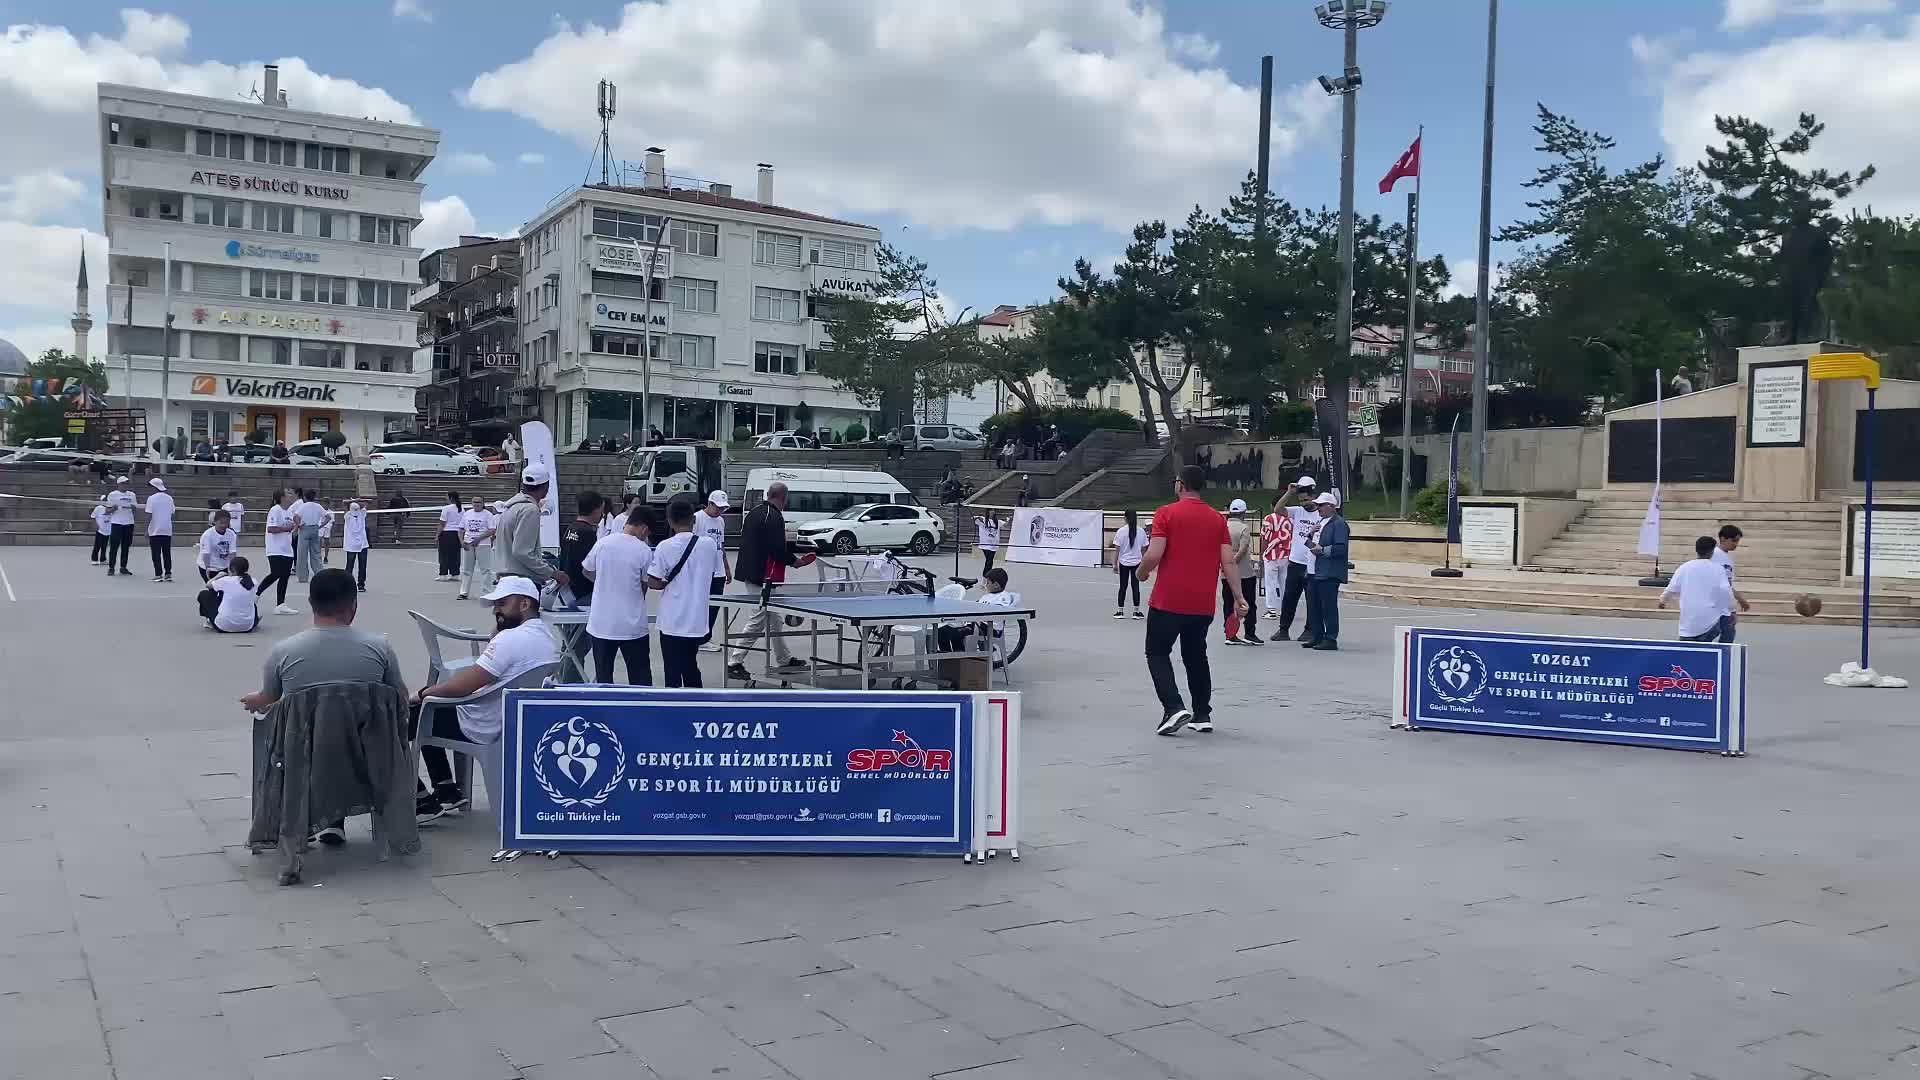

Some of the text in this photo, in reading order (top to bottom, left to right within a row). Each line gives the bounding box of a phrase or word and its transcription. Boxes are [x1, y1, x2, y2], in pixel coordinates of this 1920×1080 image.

[190, 171, 349, 200] ATEŞ SÜRÜCÜ KURSU
[600, 247, 634, 260] KÖSE
[822, 278, 869, 292] AVUKAT
[219, 311, 320, 331] AK PARTİ
[608, 311, 628, 321] CEY
[487, 354, 519, 365] OTEL
[226, 378, 337, 401] VakıfBank
[727, 386, 753, 396] Garanti
[1531, 653, 1591, 667] YOZGAT
[1494, 671, 1629, 688] GENÇLİK HİZMETLERİ
[1638, 676, 1716, 695] SPOR
[1488, 686, 1634, 705] VE SPOR İL MÜDÜRLÜĞÜ
[1429, 703, 1448, 712] Güçlü
[1450, 704, 1471, 713] Türkiye
[692, 722, 779, 739] YOZGAT
[636, 750, 833, 770] GENÇLİK HİZMETLERİ
[845, 749, 953, 772] SPOR
[627, 776, 841, 793] VE SPOR İL MÜDÜRLÜĞÜ
[536, 810, 621, 823] Güçlü Türkiye İçin
[652, 812, 706, 821] yozgat.gsb.gov.tr
[734, 812, 793, 822] yozgat@gsb.gov.tr
